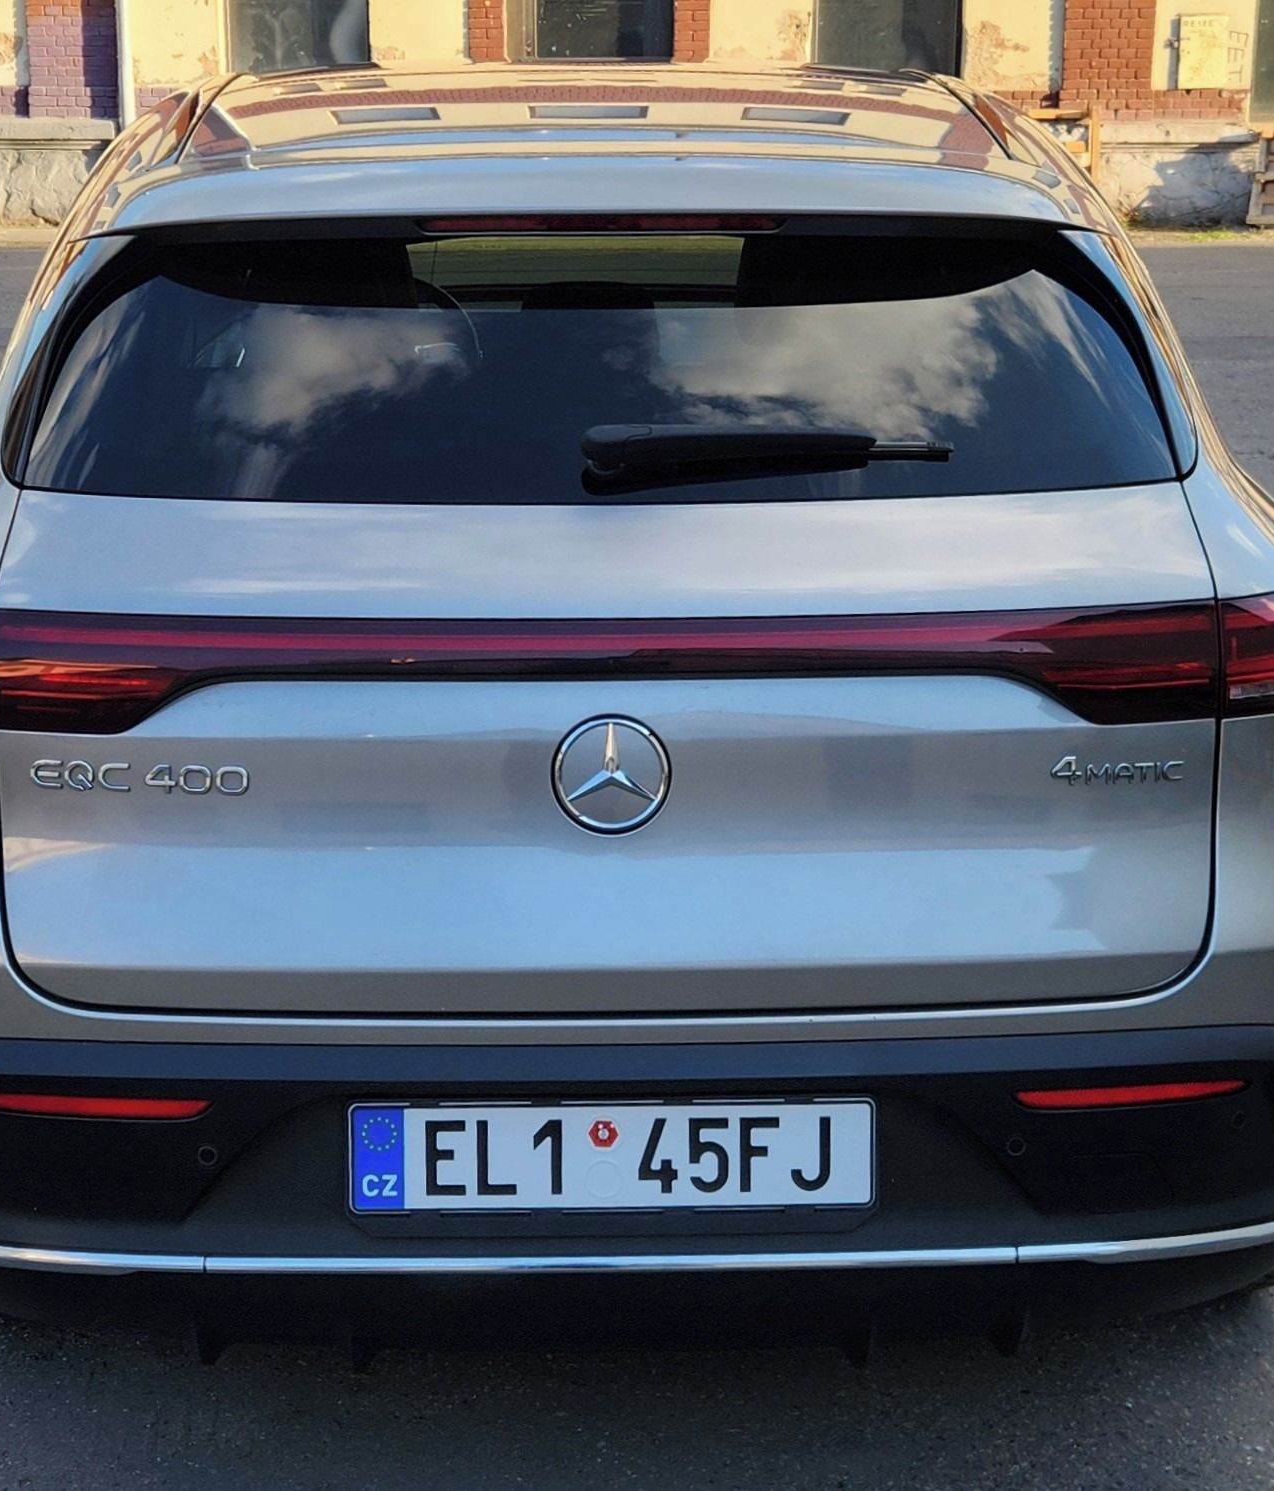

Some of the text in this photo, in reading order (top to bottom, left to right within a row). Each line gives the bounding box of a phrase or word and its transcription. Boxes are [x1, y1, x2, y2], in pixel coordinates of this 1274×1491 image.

[29, 759, 249, 794] EQC 400
[1050, 755, 1185, 786] 4MATIC
[425, 1115, 832, 1196] EL1 45FJ
[362, 1174, 398, 1197] CZ
